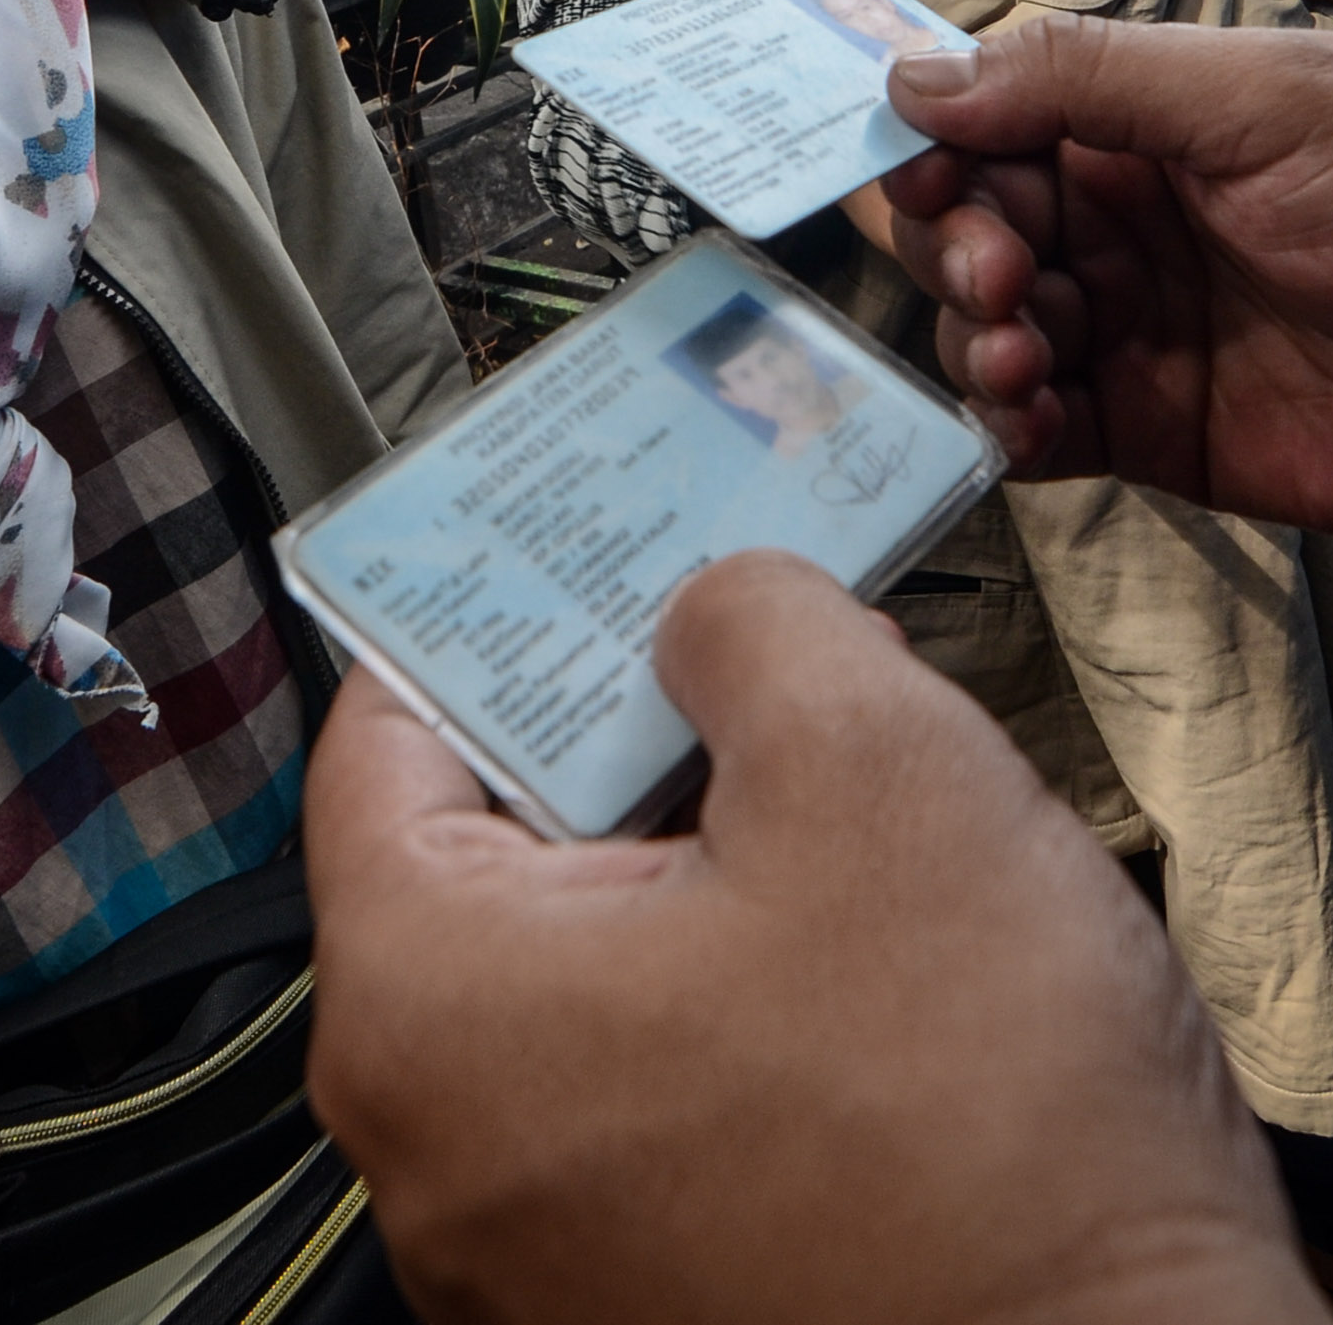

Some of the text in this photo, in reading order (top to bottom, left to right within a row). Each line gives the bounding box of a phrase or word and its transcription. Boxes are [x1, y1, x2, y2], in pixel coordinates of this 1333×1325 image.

[444, 324, 621, 458] PROVINSI JAWA BARAT
[472, 382, 574, 461] KABUPATEN
[348, 554, 399, 596] NIK
